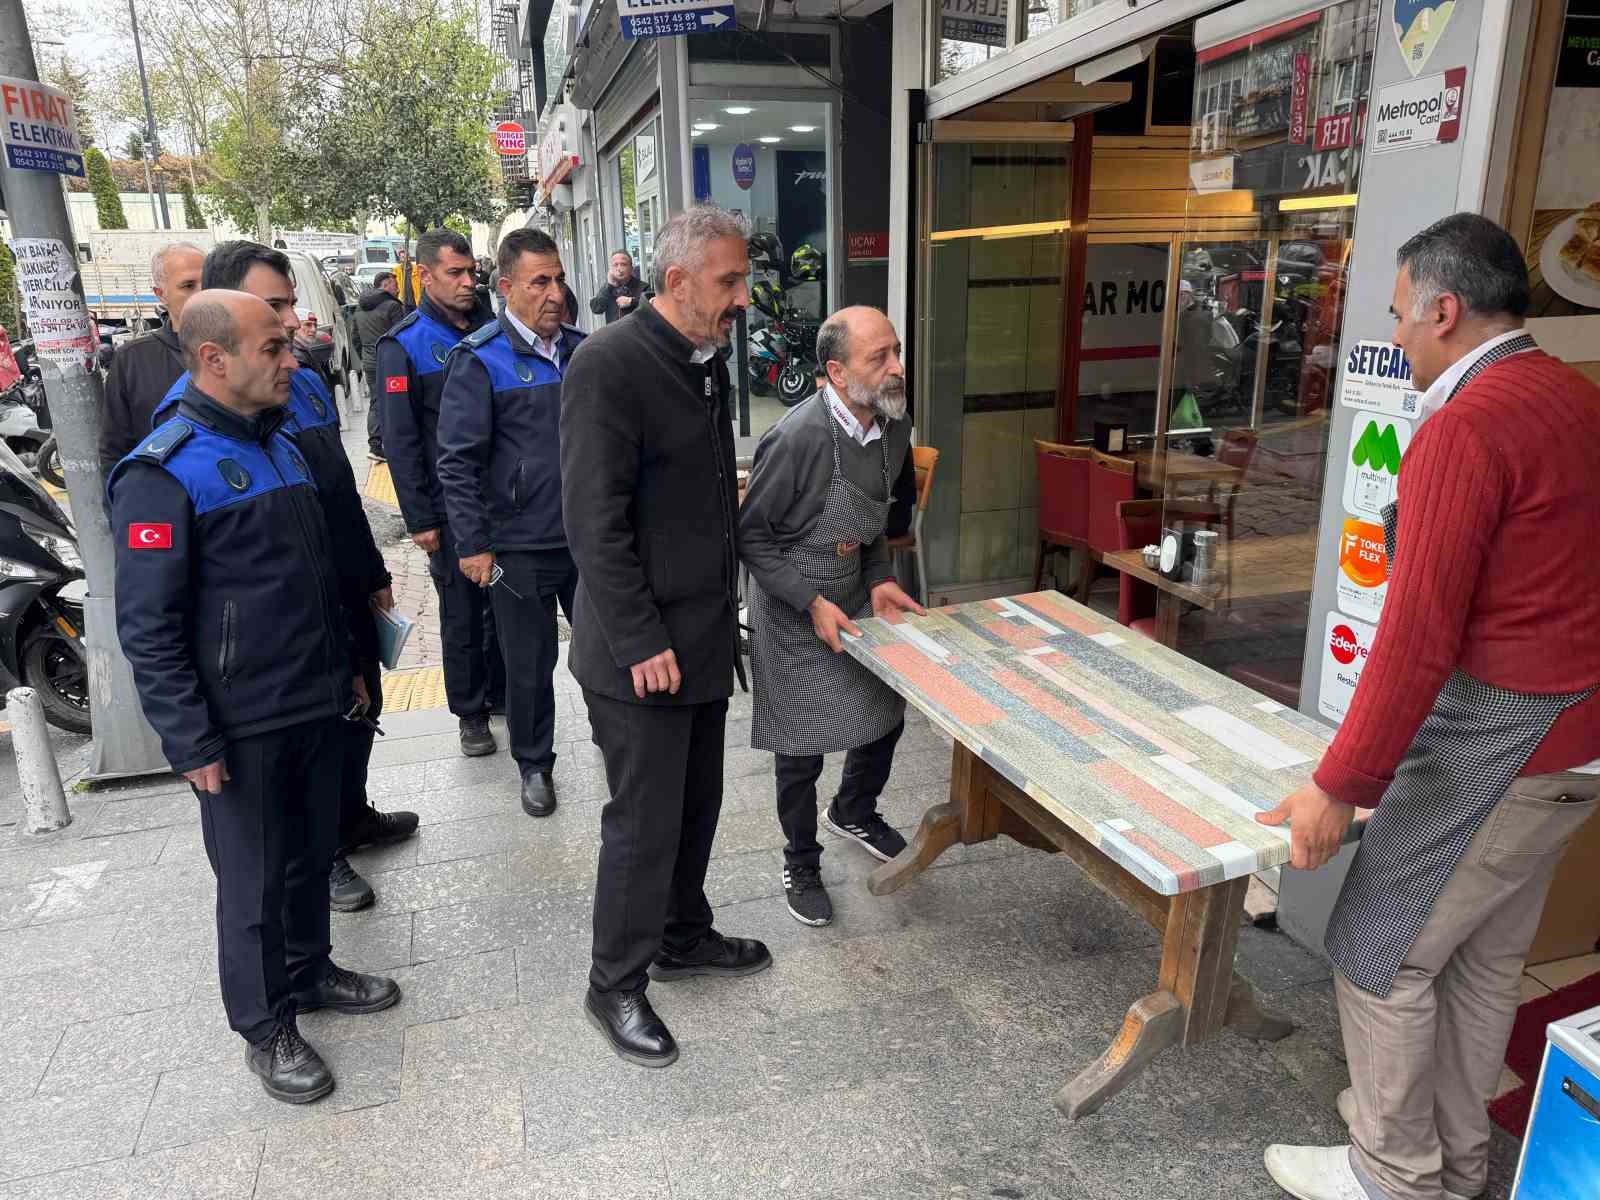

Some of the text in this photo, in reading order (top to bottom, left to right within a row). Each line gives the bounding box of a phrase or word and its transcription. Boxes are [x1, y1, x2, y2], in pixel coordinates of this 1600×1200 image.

[630, 12, 696, 26] 0542 517 45 89
[632, 22, 697, 36] 0543 325 25 23
[1, 83, 69, 127] FIRAT
[1377, 91, 1443, 122] Metropol
[1419, 112, 1441, 125] Card
[497, 139, 525, 148] KING
[851, 237, 876, 248] UCAR
[1083, 280, 1166, 316] AR MO
[1359, 550, 1381, 564] FLEX
